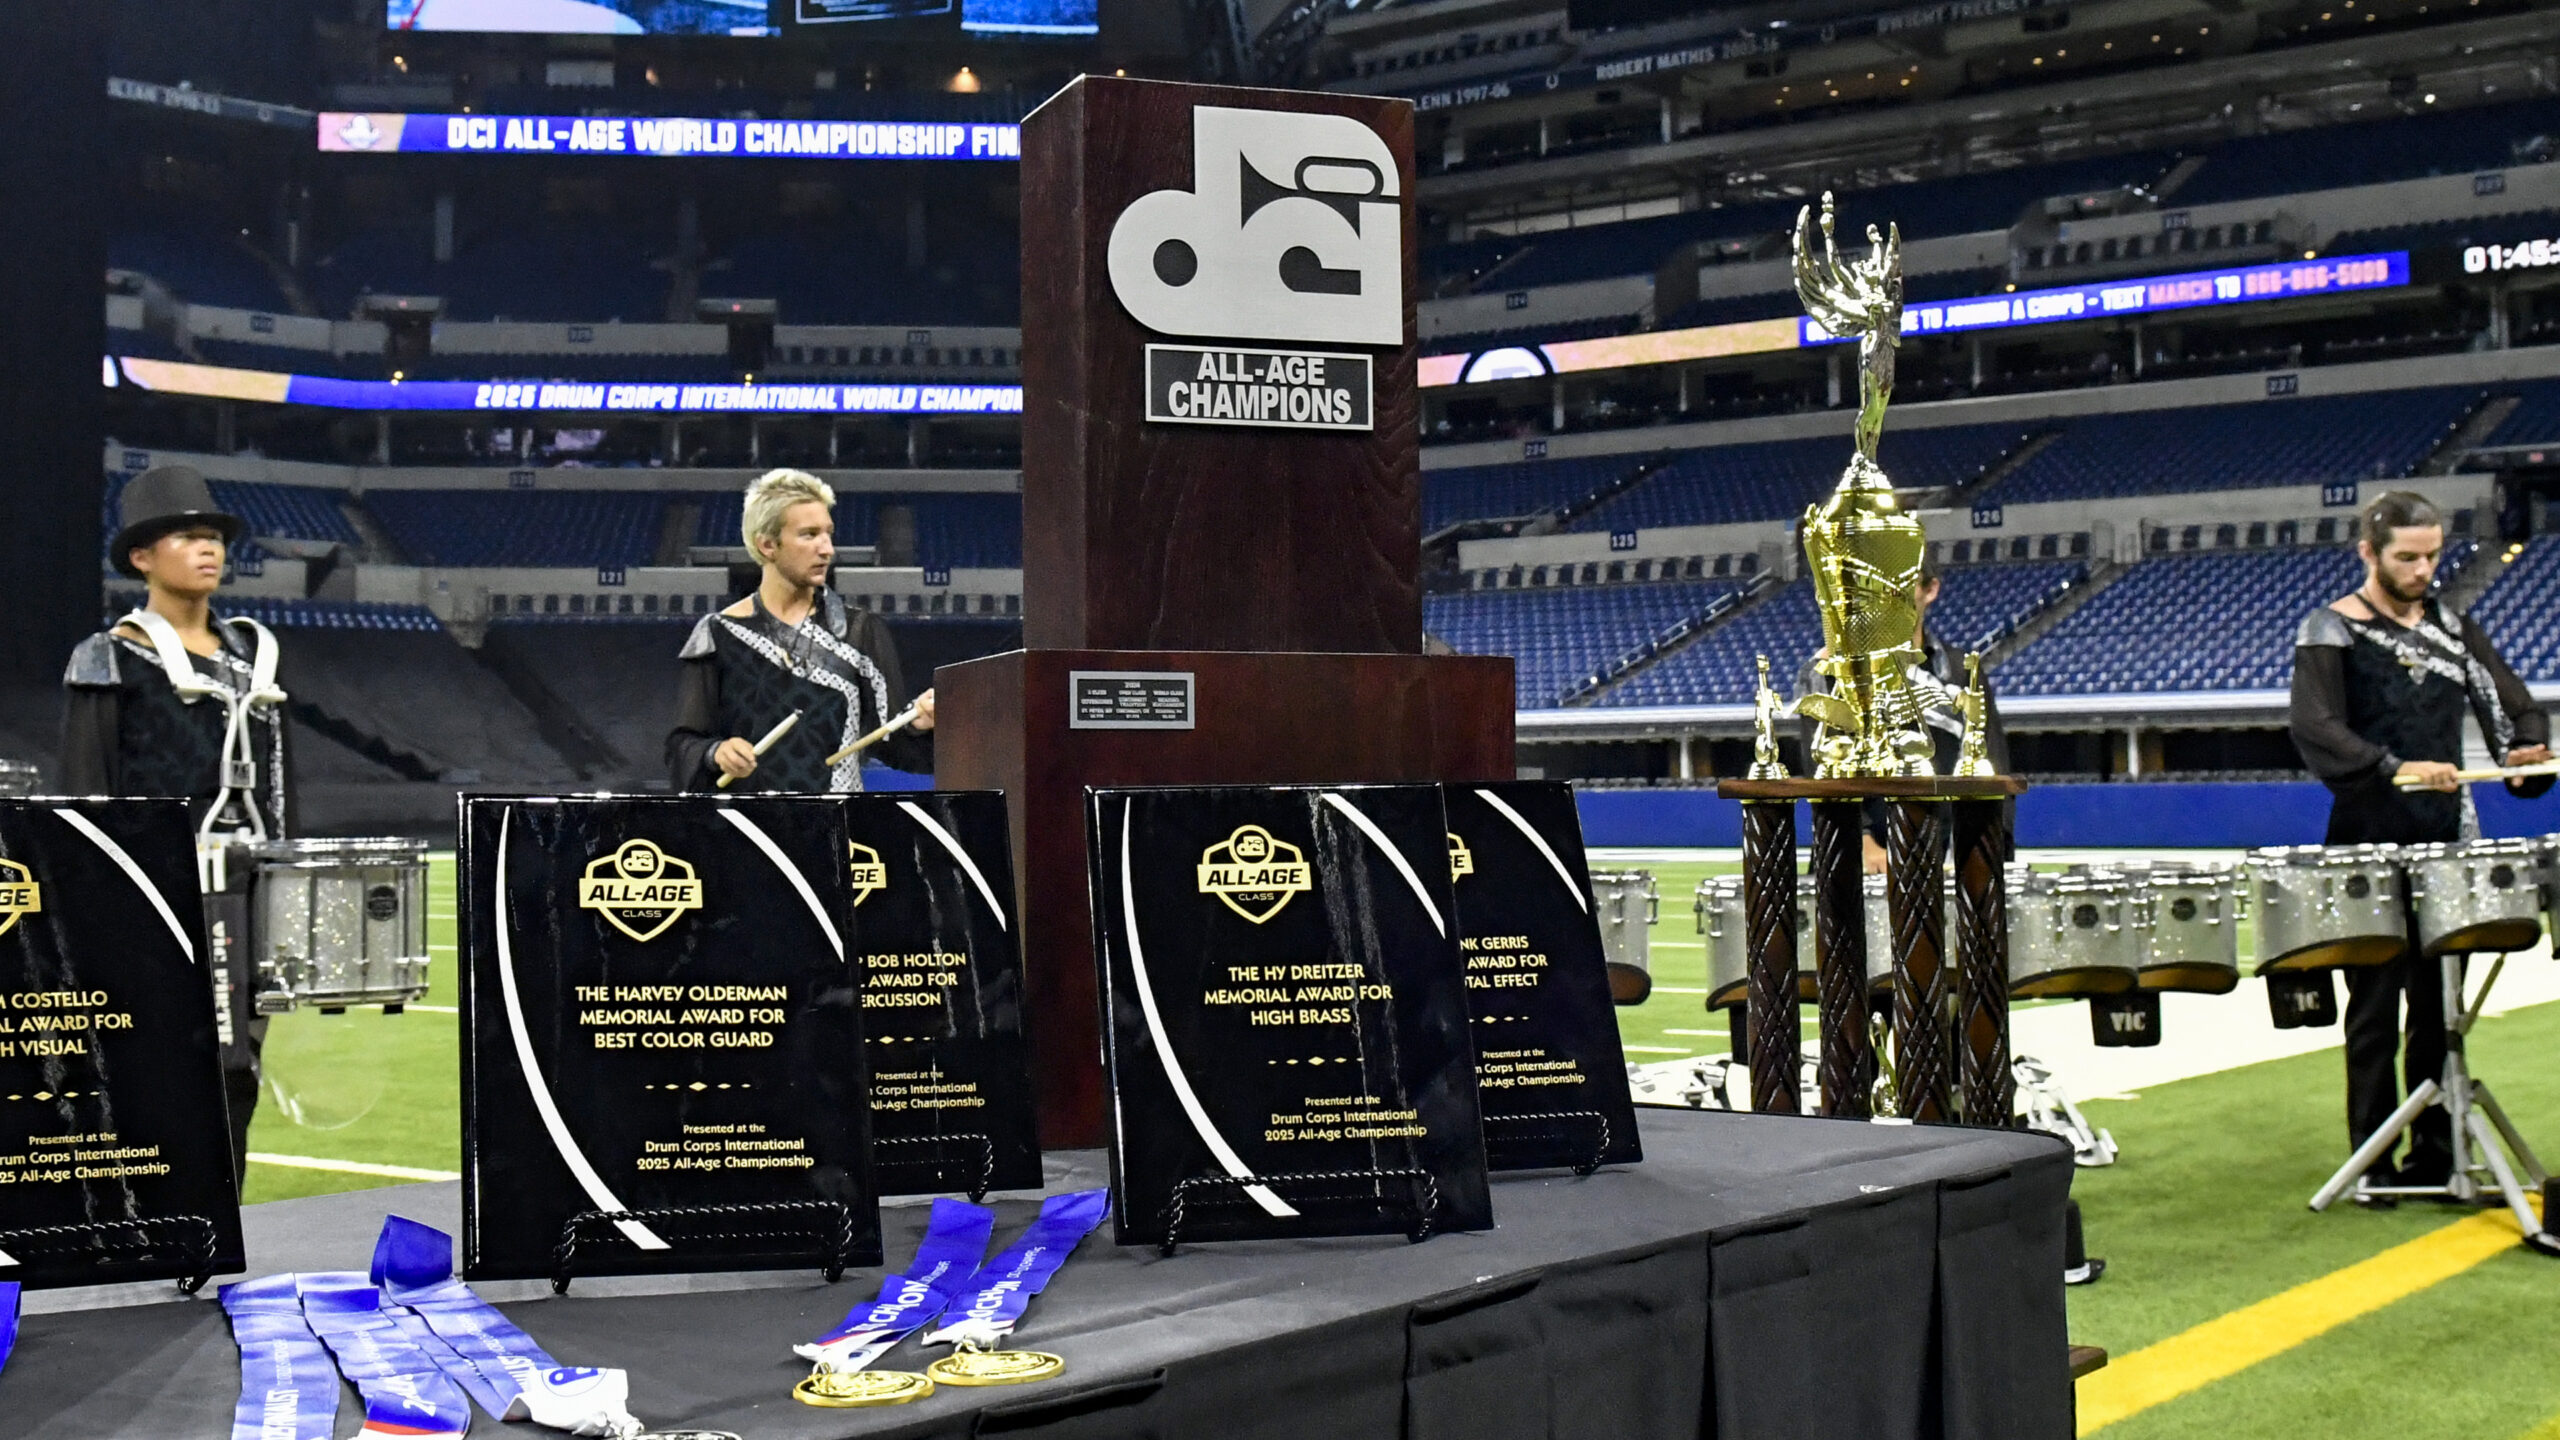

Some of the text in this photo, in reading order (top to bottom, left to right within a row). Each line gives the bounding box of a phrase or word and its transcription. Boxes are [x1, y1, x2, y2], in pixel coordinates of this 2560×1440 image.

[1596, 56, 1653, 80] ROBERT
[1414, 92, 1451, 111] LENN
[448, 117, 1020, 157] DCI ALL-AGE WORLD CHAMPIONSHIP FIN
[2012, 299, 2026, 320] A
[2101, 285, 2146, 311] TEXT
[2215, 275, 2241, 299] TO
[1197, 352, 1325, 385] ALL-AGE
[475, 384, 1023, 412] 2025 DRUM CORPS INTERNATIONAL WORLD CHAMPION
[1168, 381, 1351, 424] CHAMPIONS
[1974, 510, 2001, 525] 126
[1611, 534, 1635, 547] 125
[1206, 868, 1303, 886] ALL-AGE
[588, 885, 694, 901] ALL-AGE
[1238, 893, 1274, 901] CLASS
[622, 909, 662, 918] CLASS
[1482, 935, 1529, 950] GERRIS
[867, 954, 899, 968] BOB
[904, 953, 966, 967] HOLTON
[1467, 954, 1548, 969] AWARD FOR
[868, 972, 958, 988] AWARD FOR
[1228, 964, 1365, 982] THE HY DREITZER
[1465, 973, 1538, 988] TAL EFFECT
[11, 990, 108, 1009] COSTELLO
[575, 985, 787, 1001] THE HARVEY OLDERMAN
[862, 992, 941, 1008] ERCUSSION
[1204, 985, 1393, 1005] MEMORIAL AWARD FOR
[20, 1015, 90, 1032] AWARD
[95, 1013, 133, 1029] FOR
[580, 1008, 786, 1024] MEMORIAL AWARD FOR
[1250, 1008, 1351, 1026] HIGH BRASS
[20, 1039, 87, 1056] VISUAL
[595, 1031, 773, 1048] BEST COLOR GUARD
[1482, 1048, 1545, 1058] Presented at the
[1484, 1063, 1513, 1074] Corps
[1515, 1059, 1576, 1072] International
[875, 1070, 944, 1080] Presented at the
[1480, 1072, 1585, 1088] All-Age Championship
[876, 1085, 907, 1096] Corps
[910, 1082, 976, 1094] International
[870, 1096, 985, 1111] All-Age Championship
[1305, 1095, 1381, 1106] Presented at the
[1271, 1109, 1417, 1125] Drum Corps International
[683, 1123, 766, 1134] Presented at the
[1264, 1124, 1427, 1142] 2025 All-Age Championship
[29, 1131, 117, 1146] Presented at the
[645, 1138, 804, 1153] Drum Corps International
[0, 1145, 159, 1165] rum Corps International
[637, 1155, 814, 1171] 2025 All-Age Championship
[0, 1163, 170, 1183] 25 All-Age Championship
